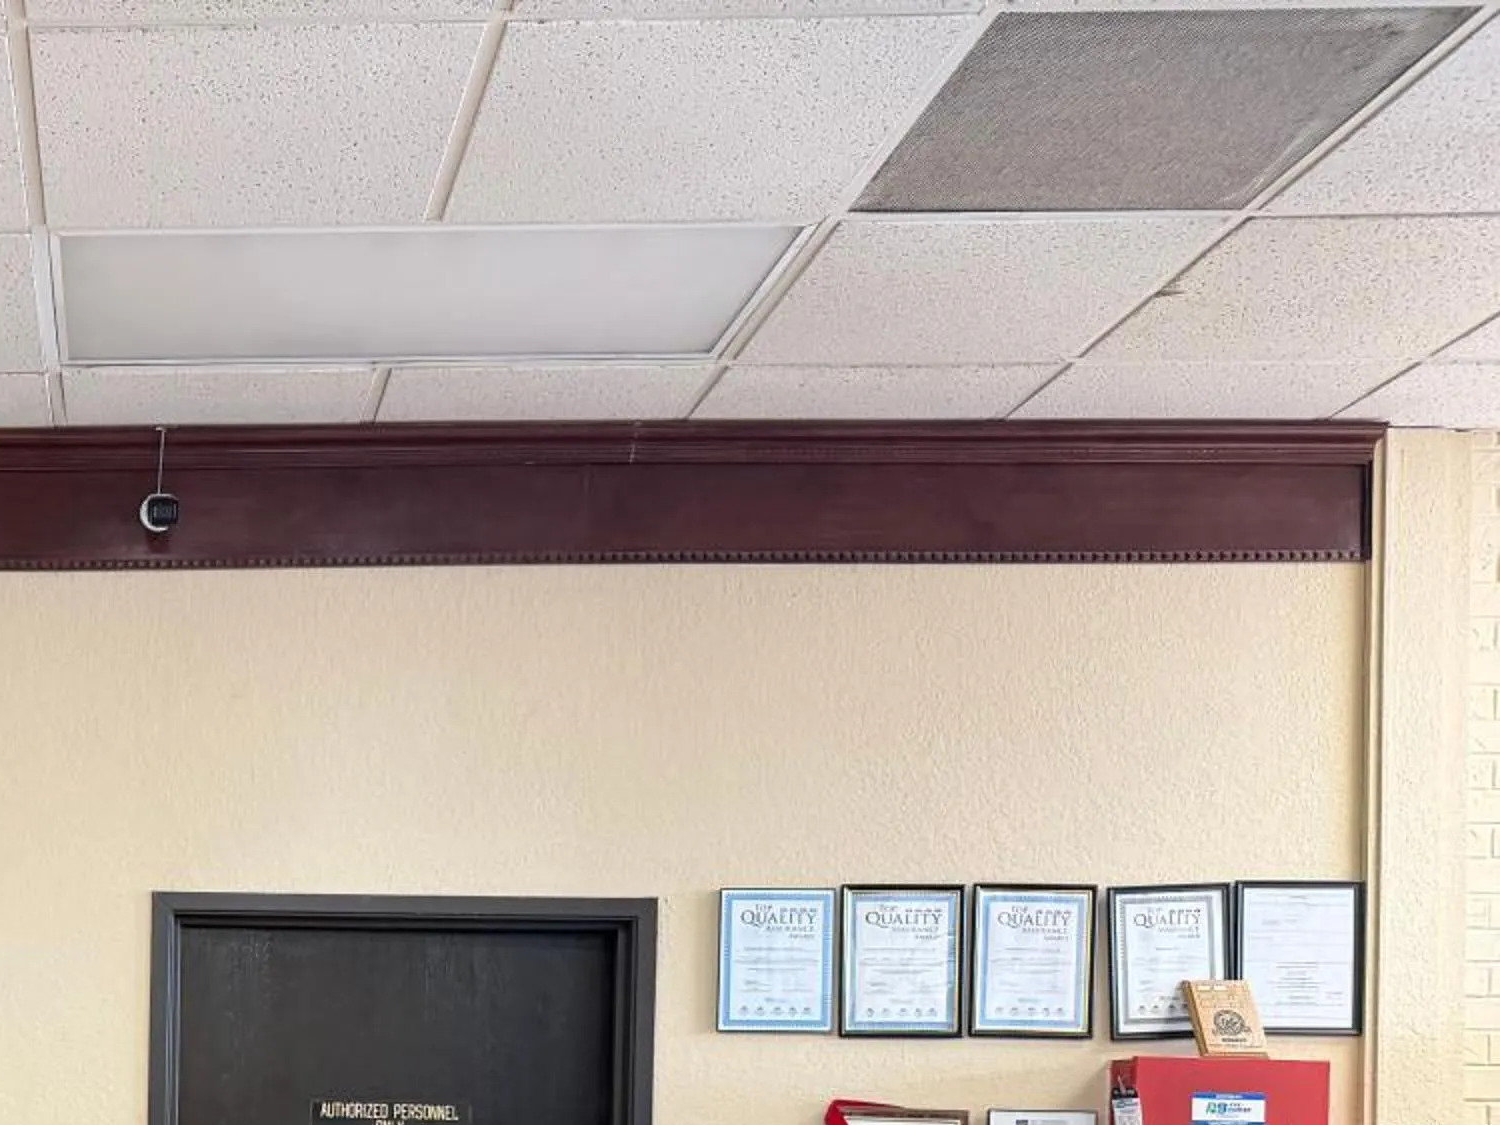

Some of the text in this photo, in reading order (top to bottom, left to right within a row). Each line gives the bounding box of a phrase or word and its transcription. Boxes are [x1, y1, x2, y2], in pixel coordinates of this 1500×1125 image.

[740, 909, 817, 928] QUALITY
[865, 911, 943, 928] QUALITY
[997, 911, 1071, 928] QUALITY
[1133, 912, 1200, 928] QUALITY
[320, 1102, 459, 1121] AUTHORIZED PERSONNEL
